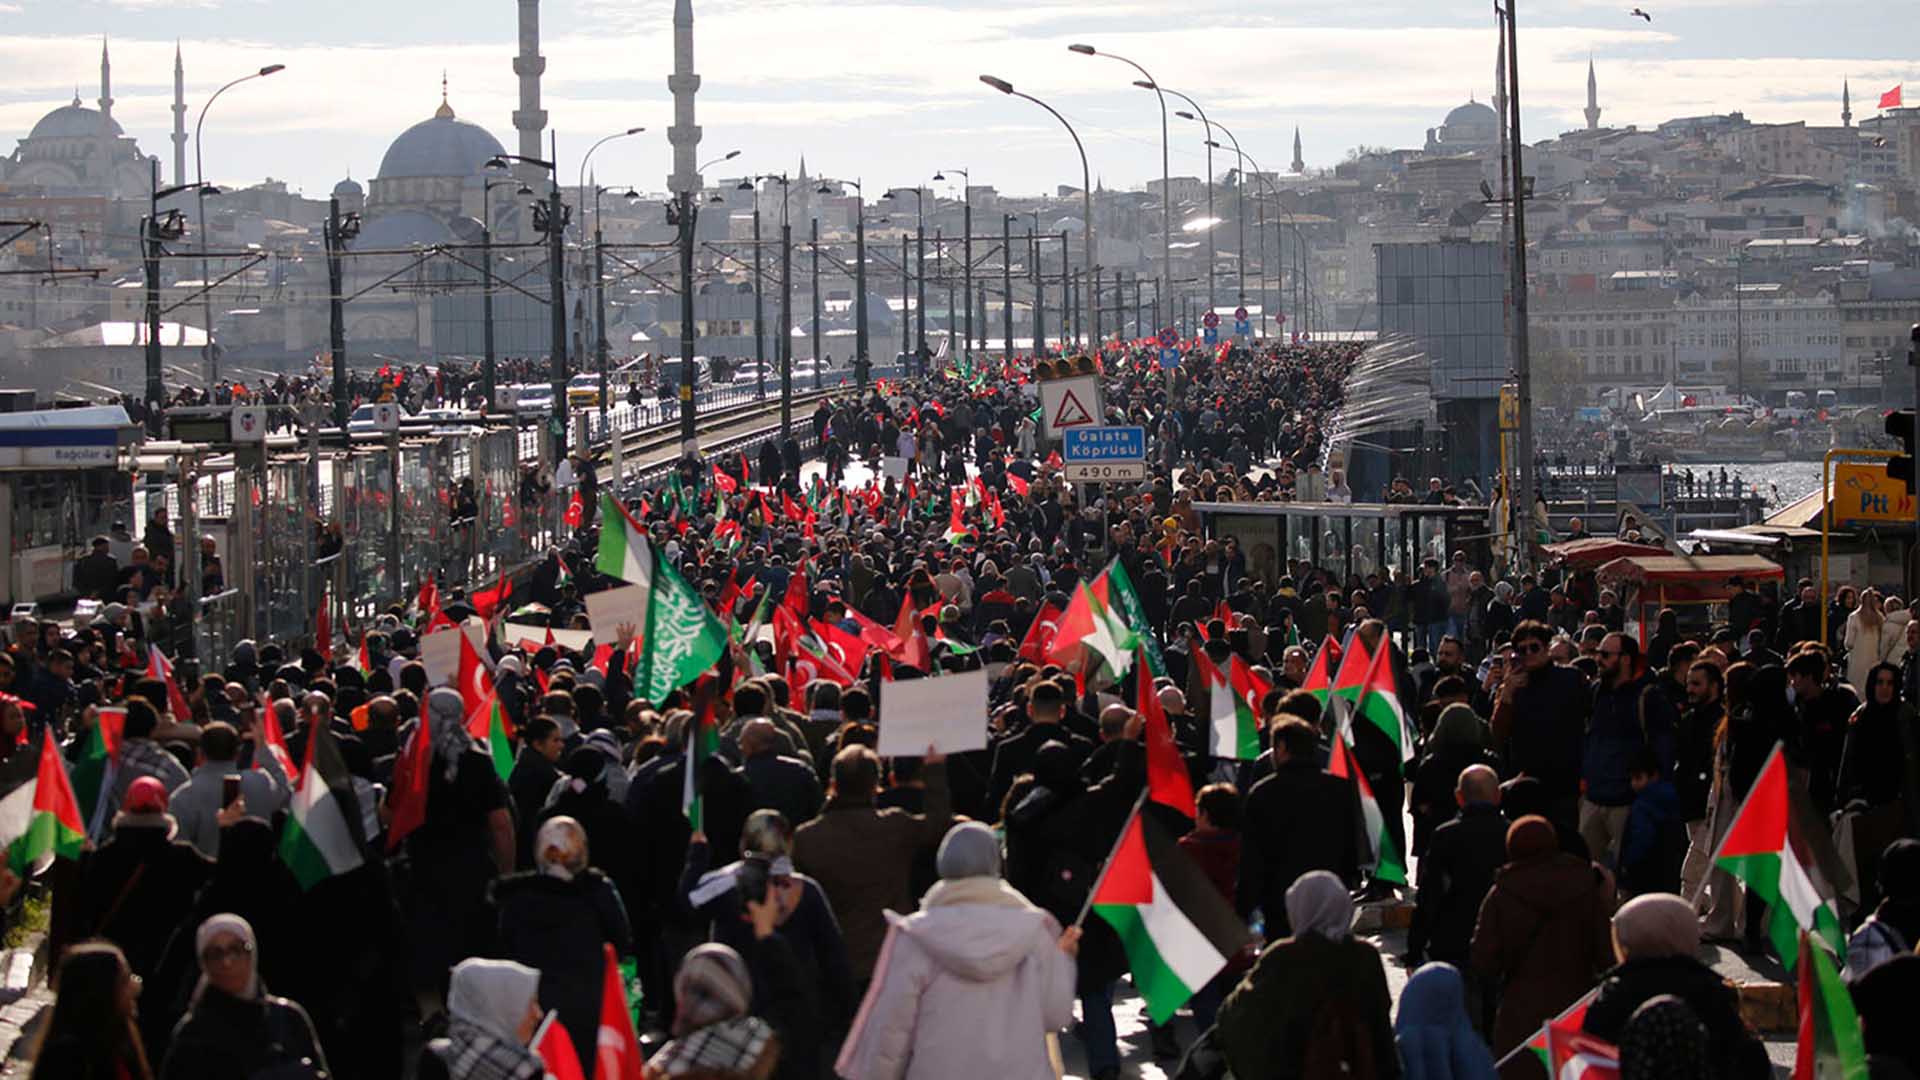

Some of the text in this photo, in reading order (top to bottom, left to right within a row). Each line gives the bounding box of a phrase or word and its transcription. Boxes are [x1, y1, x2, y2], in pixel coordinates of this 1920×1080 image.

[1080, 431, 1129, 441] Galata
[1072, 444, 1137, 457] Köprüsü
[1080, 466, 1131, 477] 490 m
